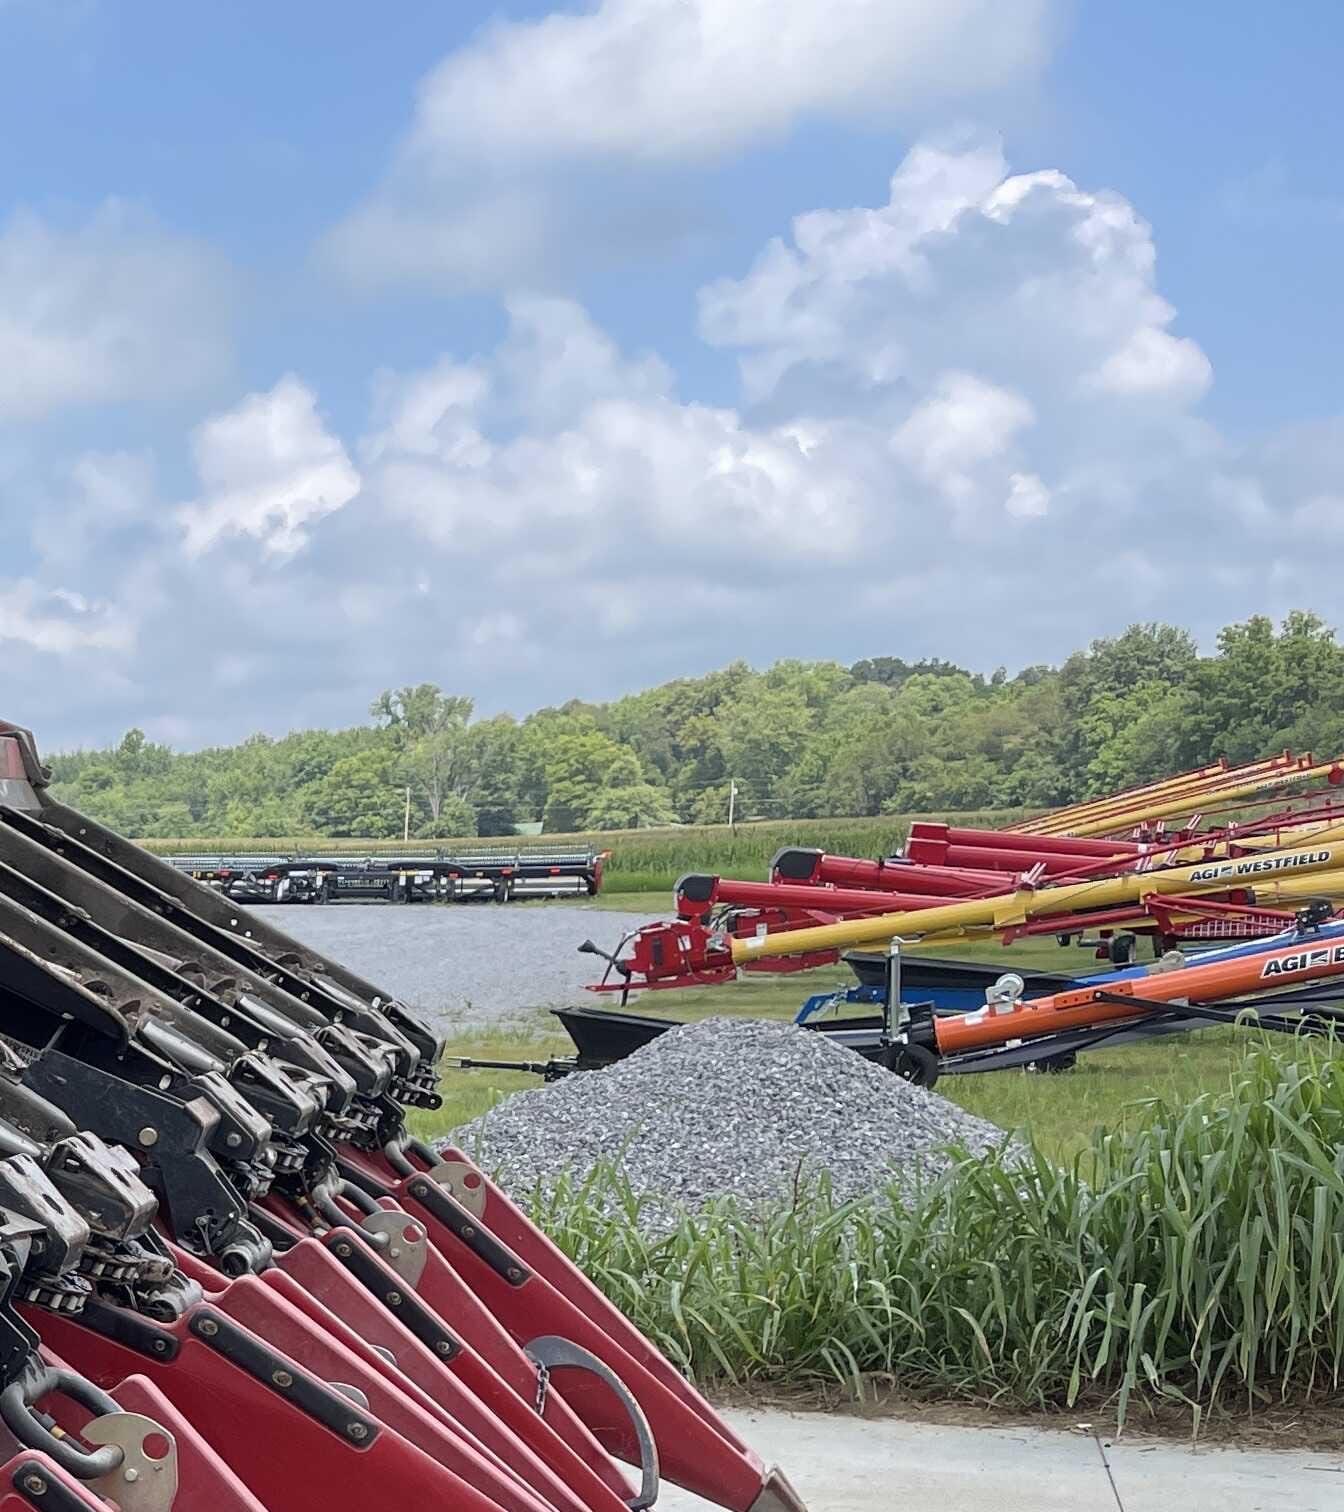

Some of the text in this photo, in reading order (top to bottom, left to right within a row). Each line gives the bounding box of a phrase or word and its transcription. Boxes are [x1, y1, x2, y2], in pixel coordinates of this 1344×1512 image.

[1190, 851, 1330, 882] AGI WESTFIELD
[1264, 952, 1307, 976] AGI
